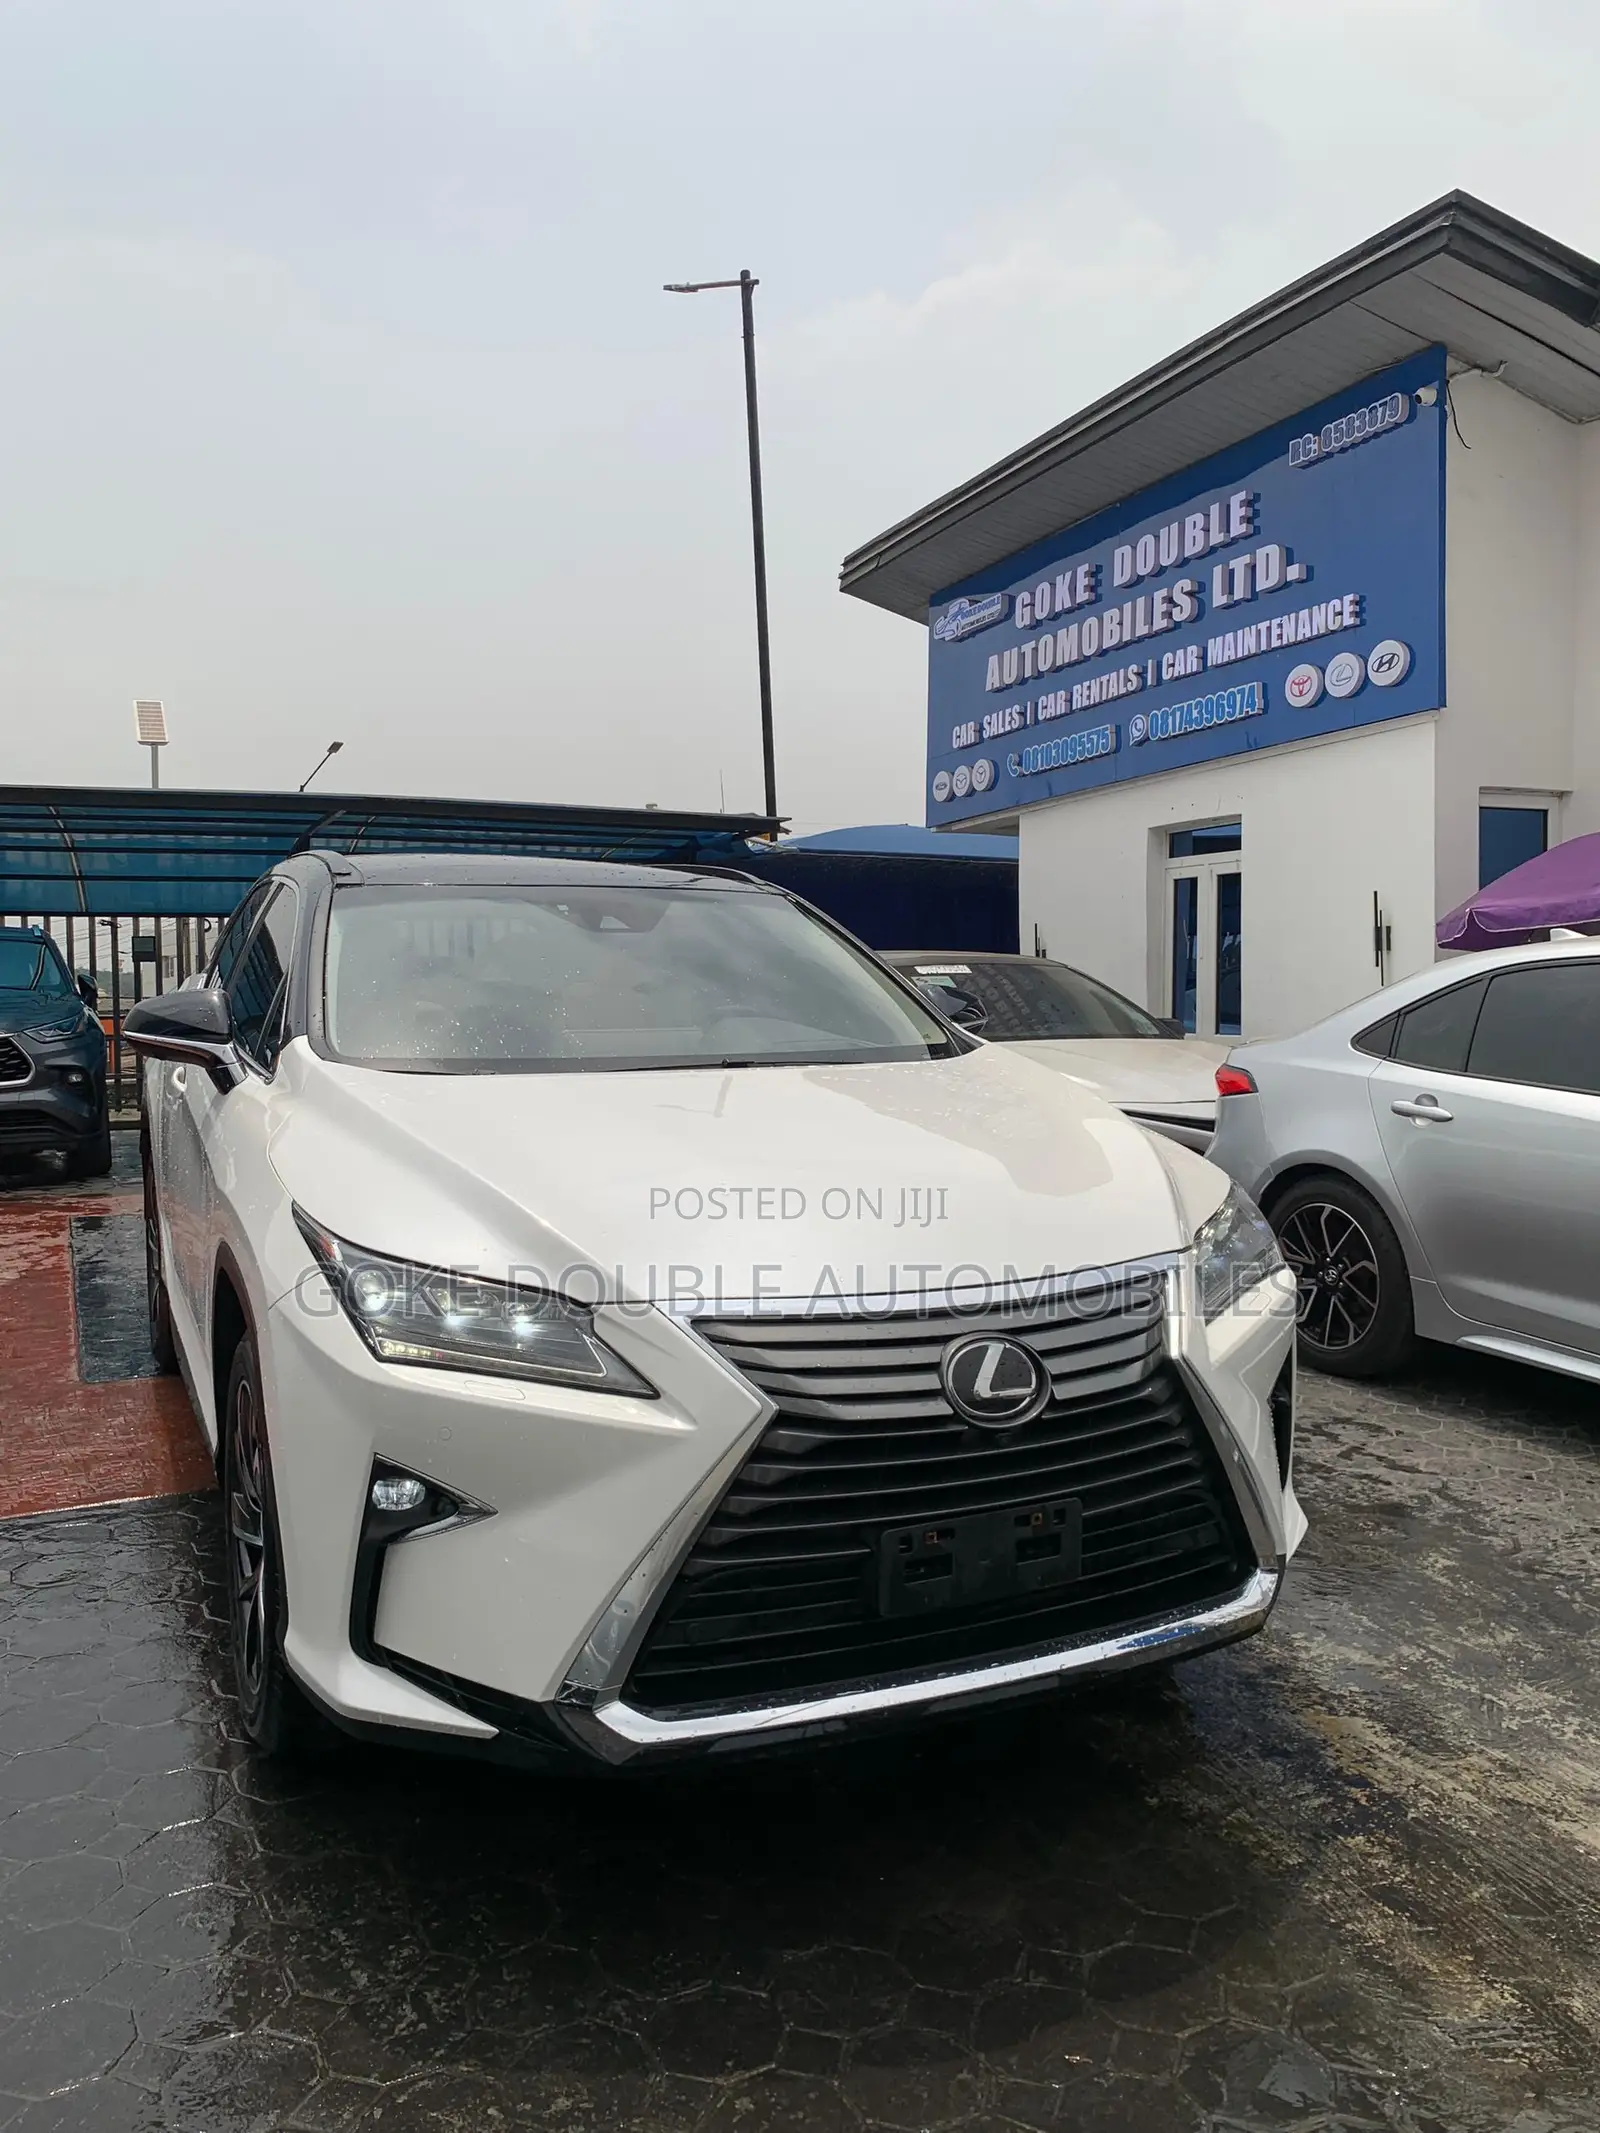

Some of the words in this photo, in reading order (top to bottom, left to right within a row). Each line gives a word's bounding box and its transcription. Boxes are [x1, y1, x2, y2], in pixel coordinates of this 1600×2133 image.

[1289, 433, 1319, 465] RC:
[986, 578, 1192, 692] AUTOMOBILES
[1212, 543, 1301, 608] LTD.
[1015, 562, 1091, 629] GOKE
[1113, 490, 1248, 587] DOUBLE
[953, 721, 976, 749] CAR
[982, 704, 1021, 739] SALES
[1037, 690, 1067, 721] CAR
[1072, 664, 1138, 710] RENTALS
[1162, 645, 1199, 681] CAR
[1207, 593, 1357, 667] MAINTENANCE
[1149, 681, 1258, 741] 08174396974
